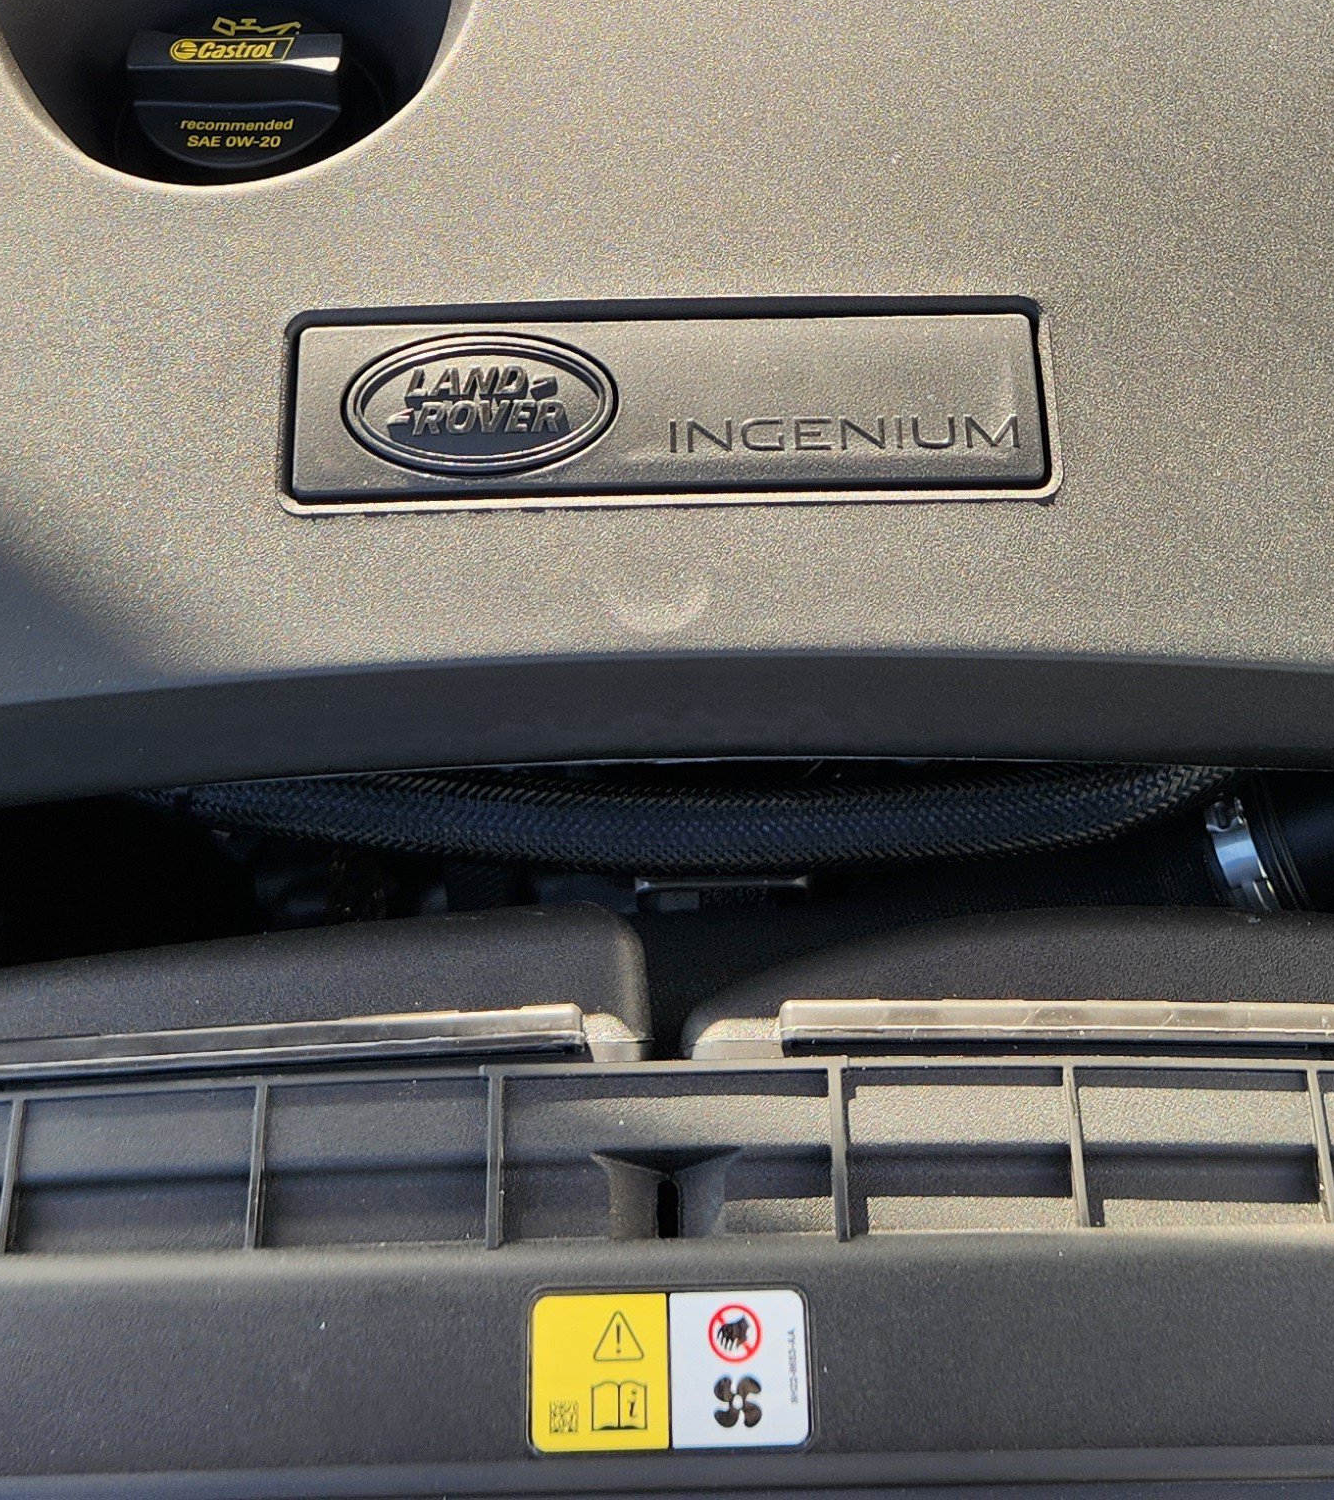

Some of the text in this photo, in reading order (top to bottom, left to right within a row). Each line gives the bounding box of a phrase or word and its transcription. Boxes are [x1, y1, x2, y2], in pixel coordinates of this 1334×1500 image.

[197, 40, 275, 60] Castrol
[179, 118, 294, 132] recommended
[186, 135, 282, 149] SAE 0W-20
[404, 363, 530, 398] LAND
[412, 398, 568, 436] ROVER
[668, 415, 1021, 454] INGENIUM
